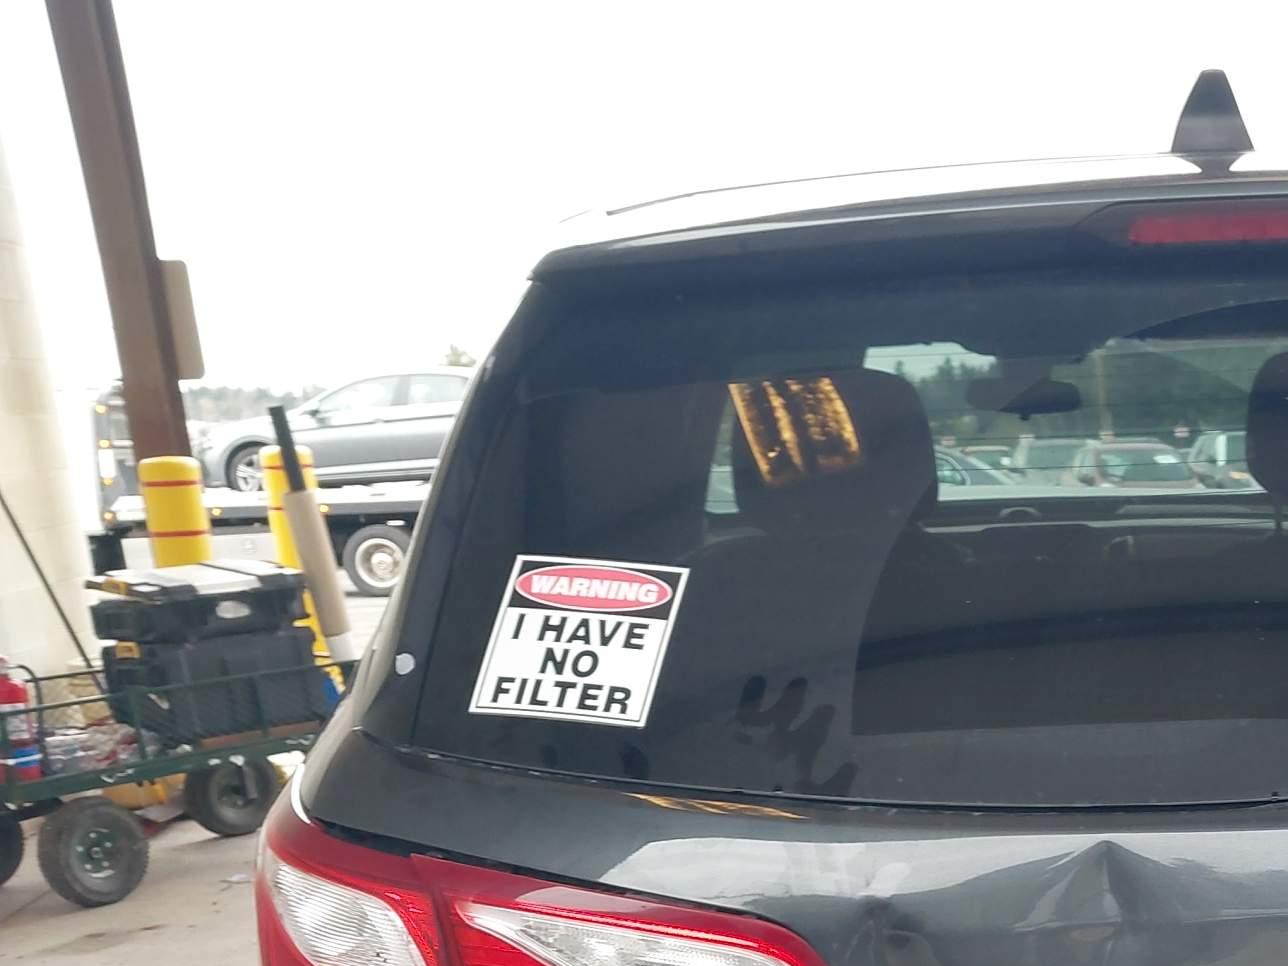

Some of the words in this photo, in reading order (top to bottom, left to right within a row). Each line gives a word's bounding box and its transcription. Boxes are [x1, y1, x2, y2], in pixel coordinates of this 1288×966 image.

[530, 574, 660, 603] WARNING
[511, 613, 526, 640] I
[537, 615, 650, 650] HAVE
[538, 647, 599, 678] NO
[490, 676, 632, 715] FILTER
